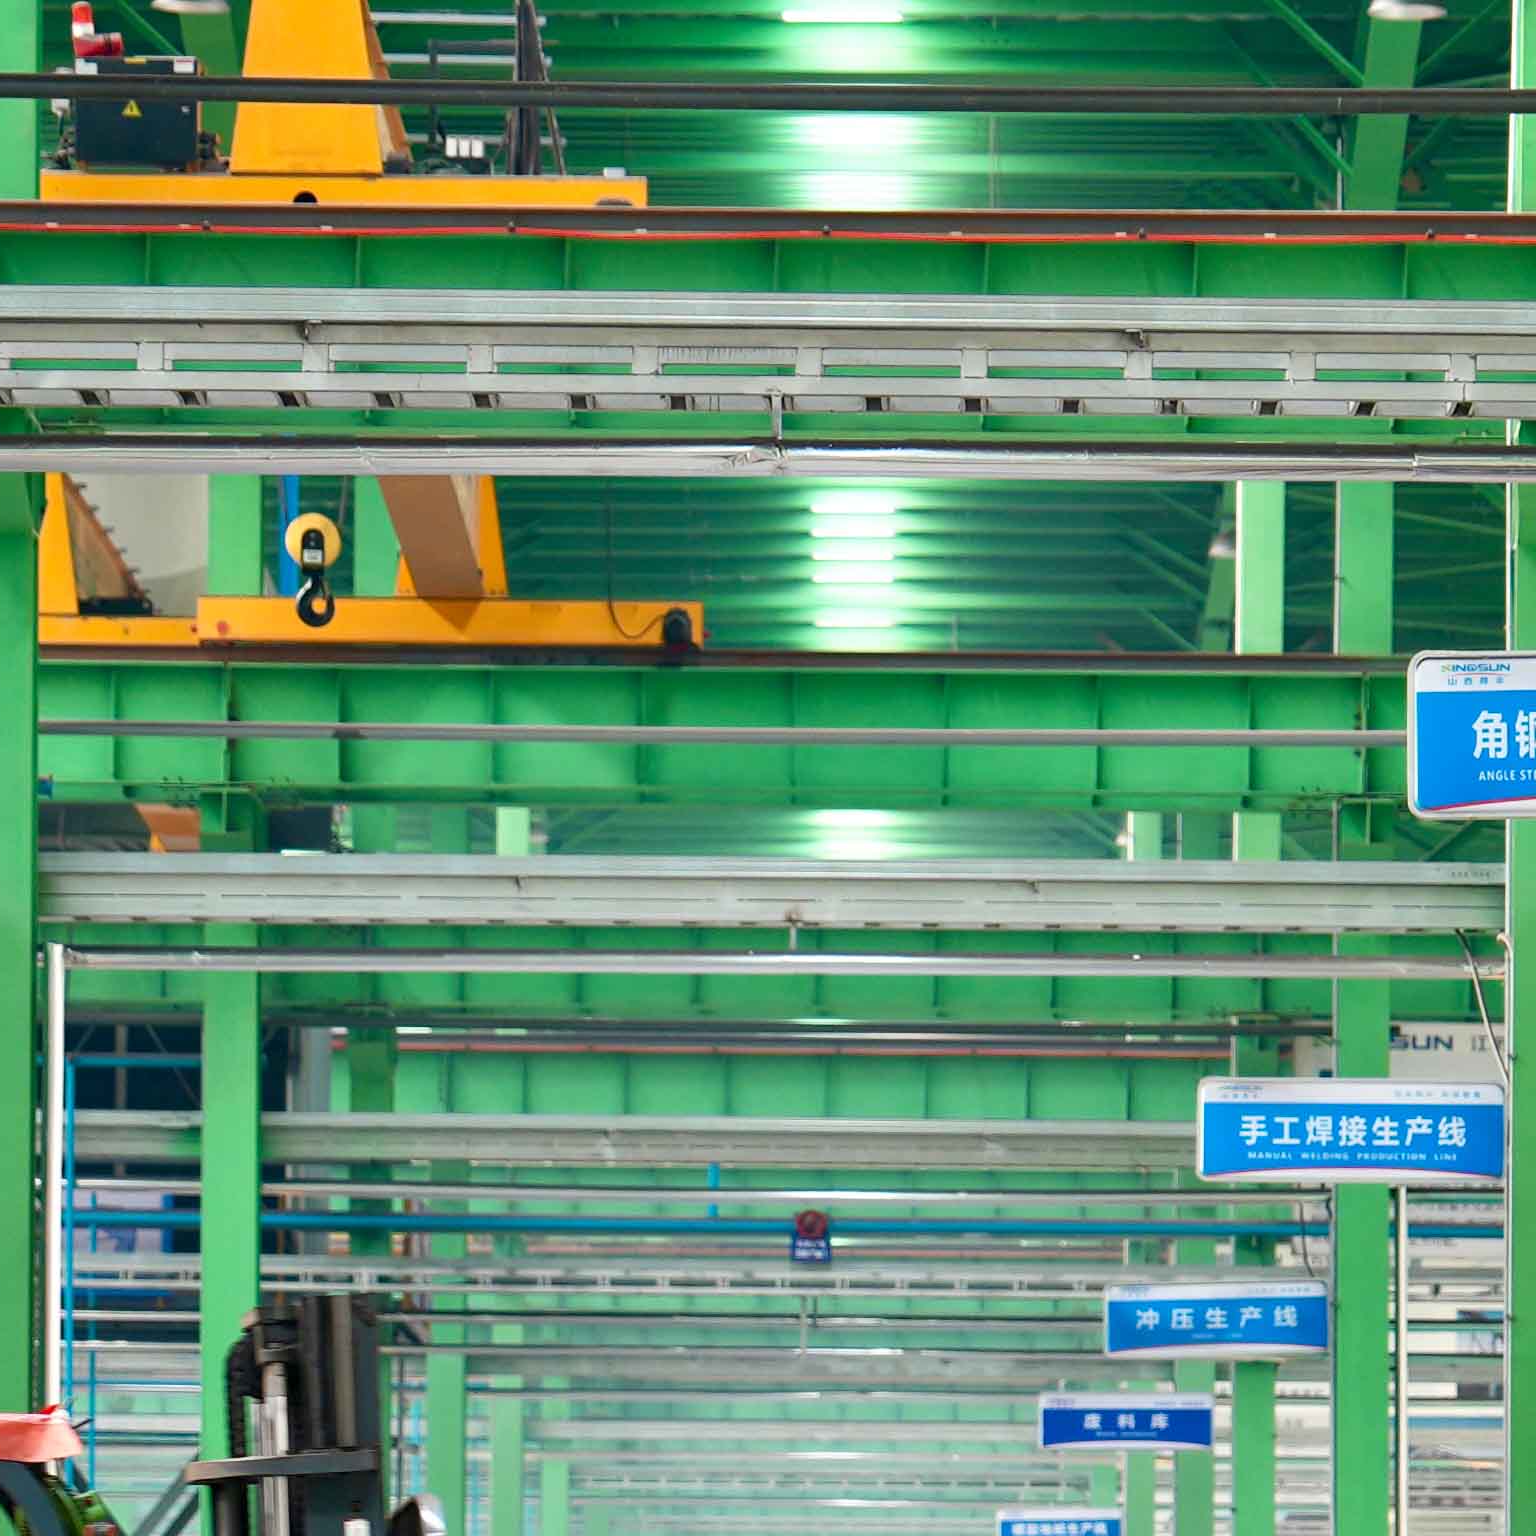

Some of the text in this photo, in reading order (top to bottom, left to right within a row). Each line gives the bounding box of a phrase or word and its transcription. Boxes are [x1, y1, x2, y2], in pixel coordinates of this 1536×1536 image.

[1478, 770, 1517, 782] ANGLE
[1239, 1115, 1466, 1147] 手工焊接生产线
[1247, 1151, 1292, 1160] MANUAL
[1300, 1151, 1350, 1161] WELDING
[1356, 1152, 1427, 1161] PRODUCTION
[1136, 1305, 1298, 1331] 冲压生产线
